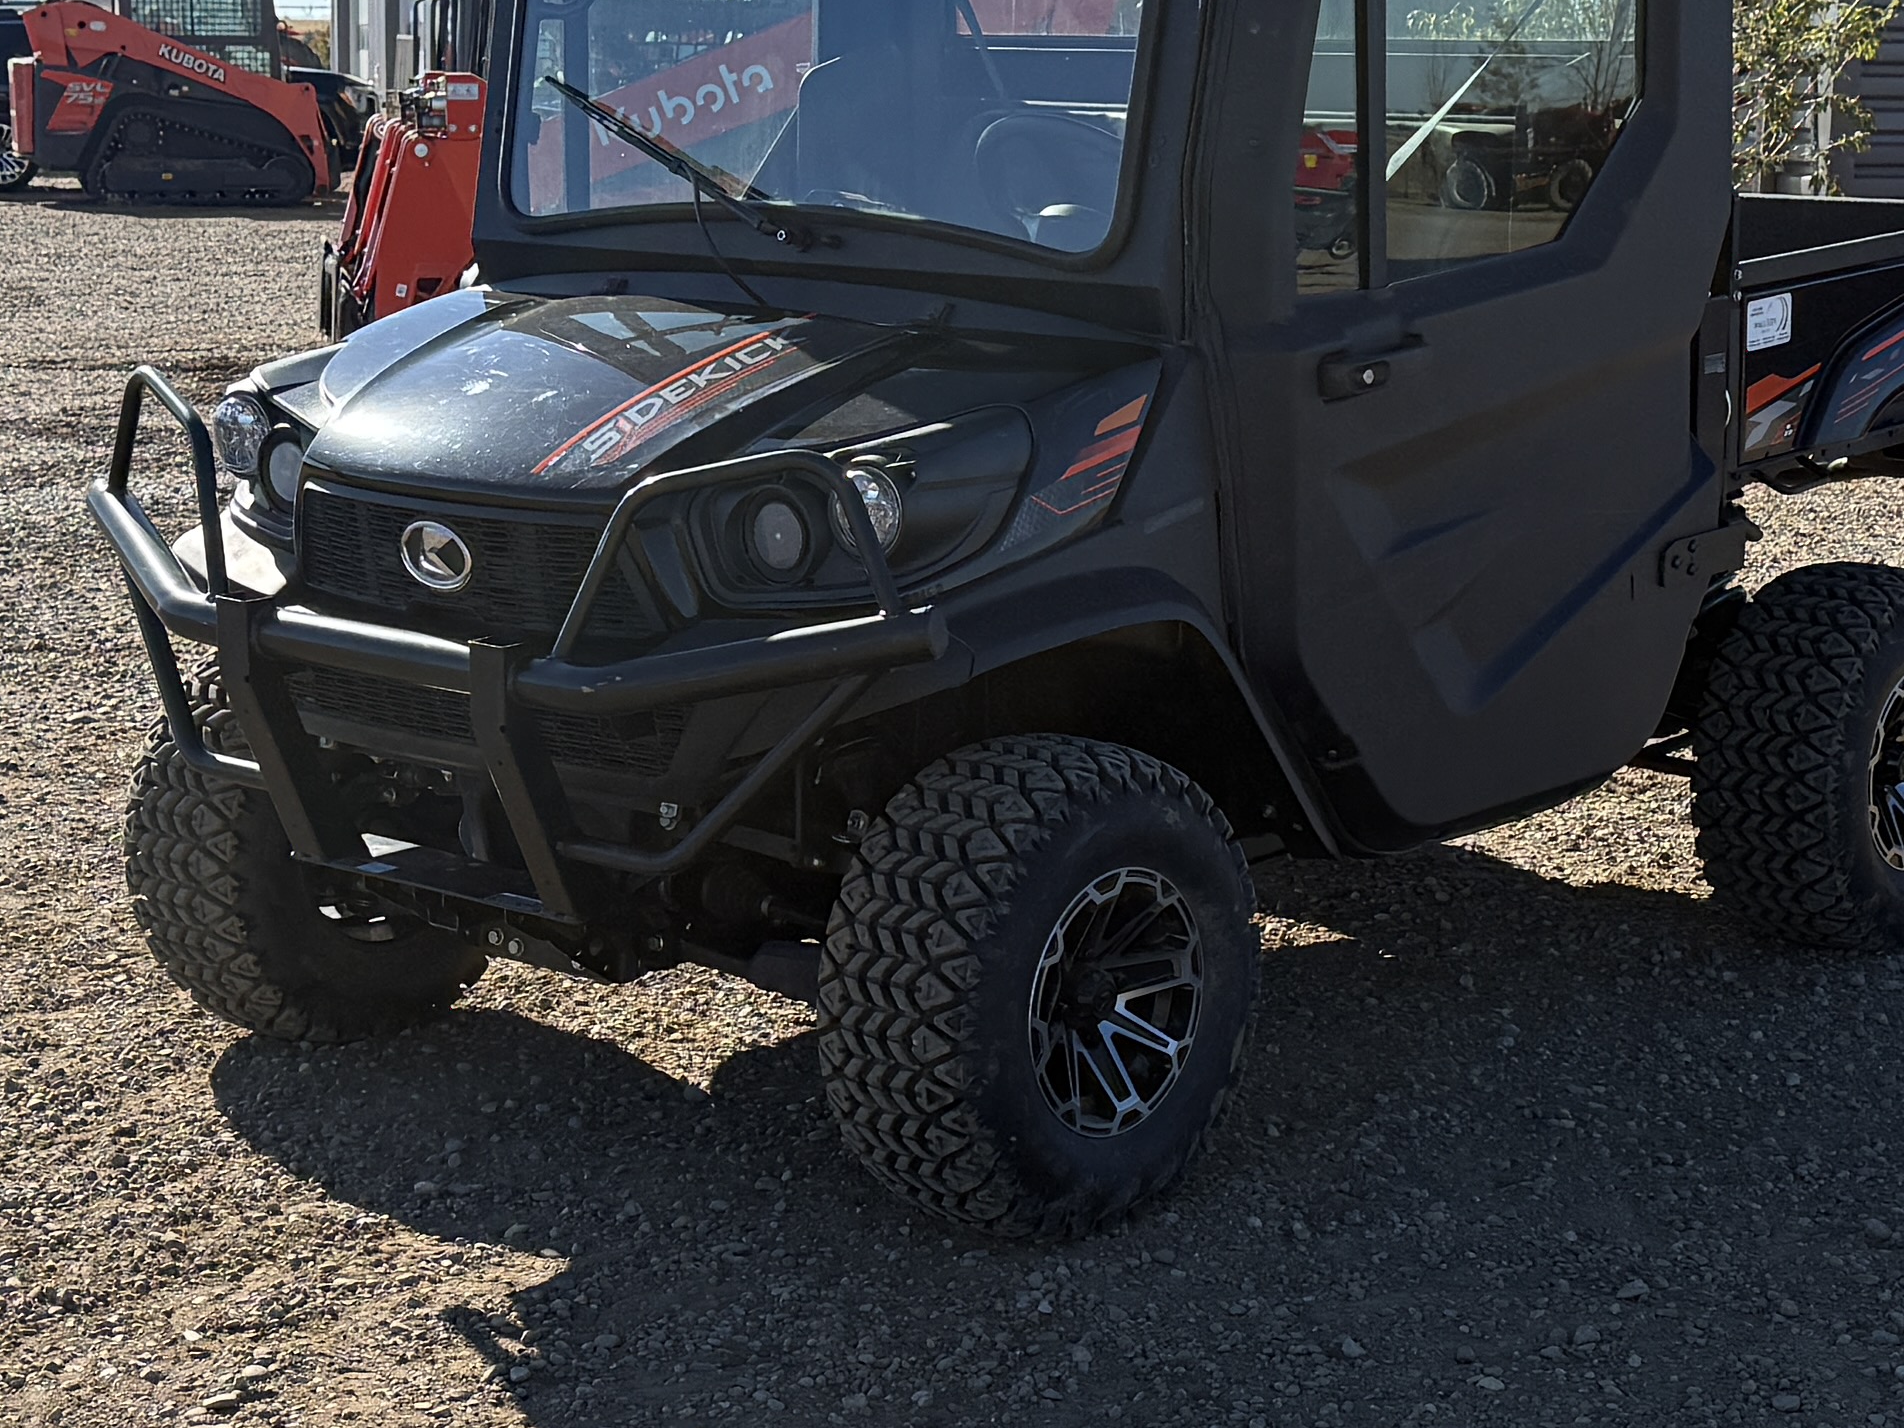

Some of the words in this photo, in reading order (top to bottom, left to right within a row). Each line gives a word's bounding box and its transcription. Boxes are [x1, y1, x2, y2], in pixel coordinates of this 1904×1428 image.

[157, 43, 226, 83] KUBOTA
[67, 82, 109, 93] SVL
[583, 334, 794, 462] SIDEKICK
